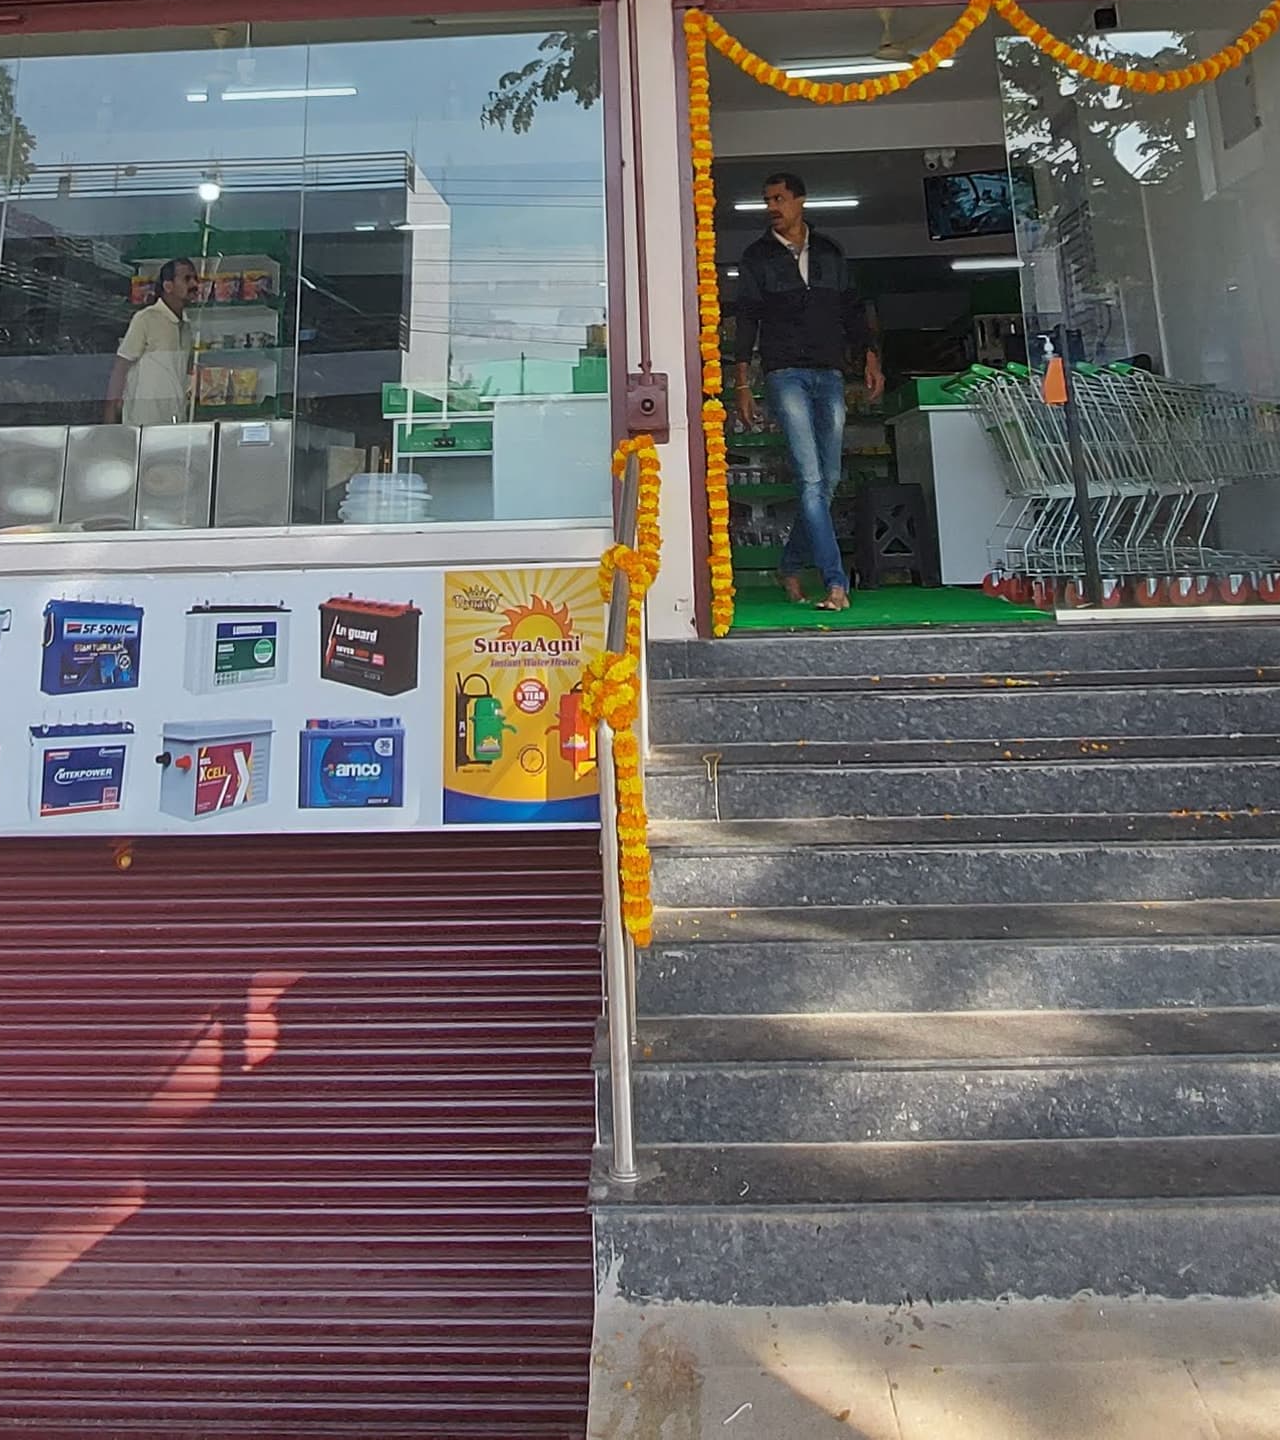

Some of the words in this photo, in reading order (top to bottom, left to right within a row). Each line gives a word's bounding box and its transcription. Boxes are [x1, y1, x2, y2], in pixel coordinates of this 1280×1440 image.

[98, 623, 136, 635] SONIC
[473, 634, 582, 657] SuryaAgni
[336, 762, 382, 777] amco
